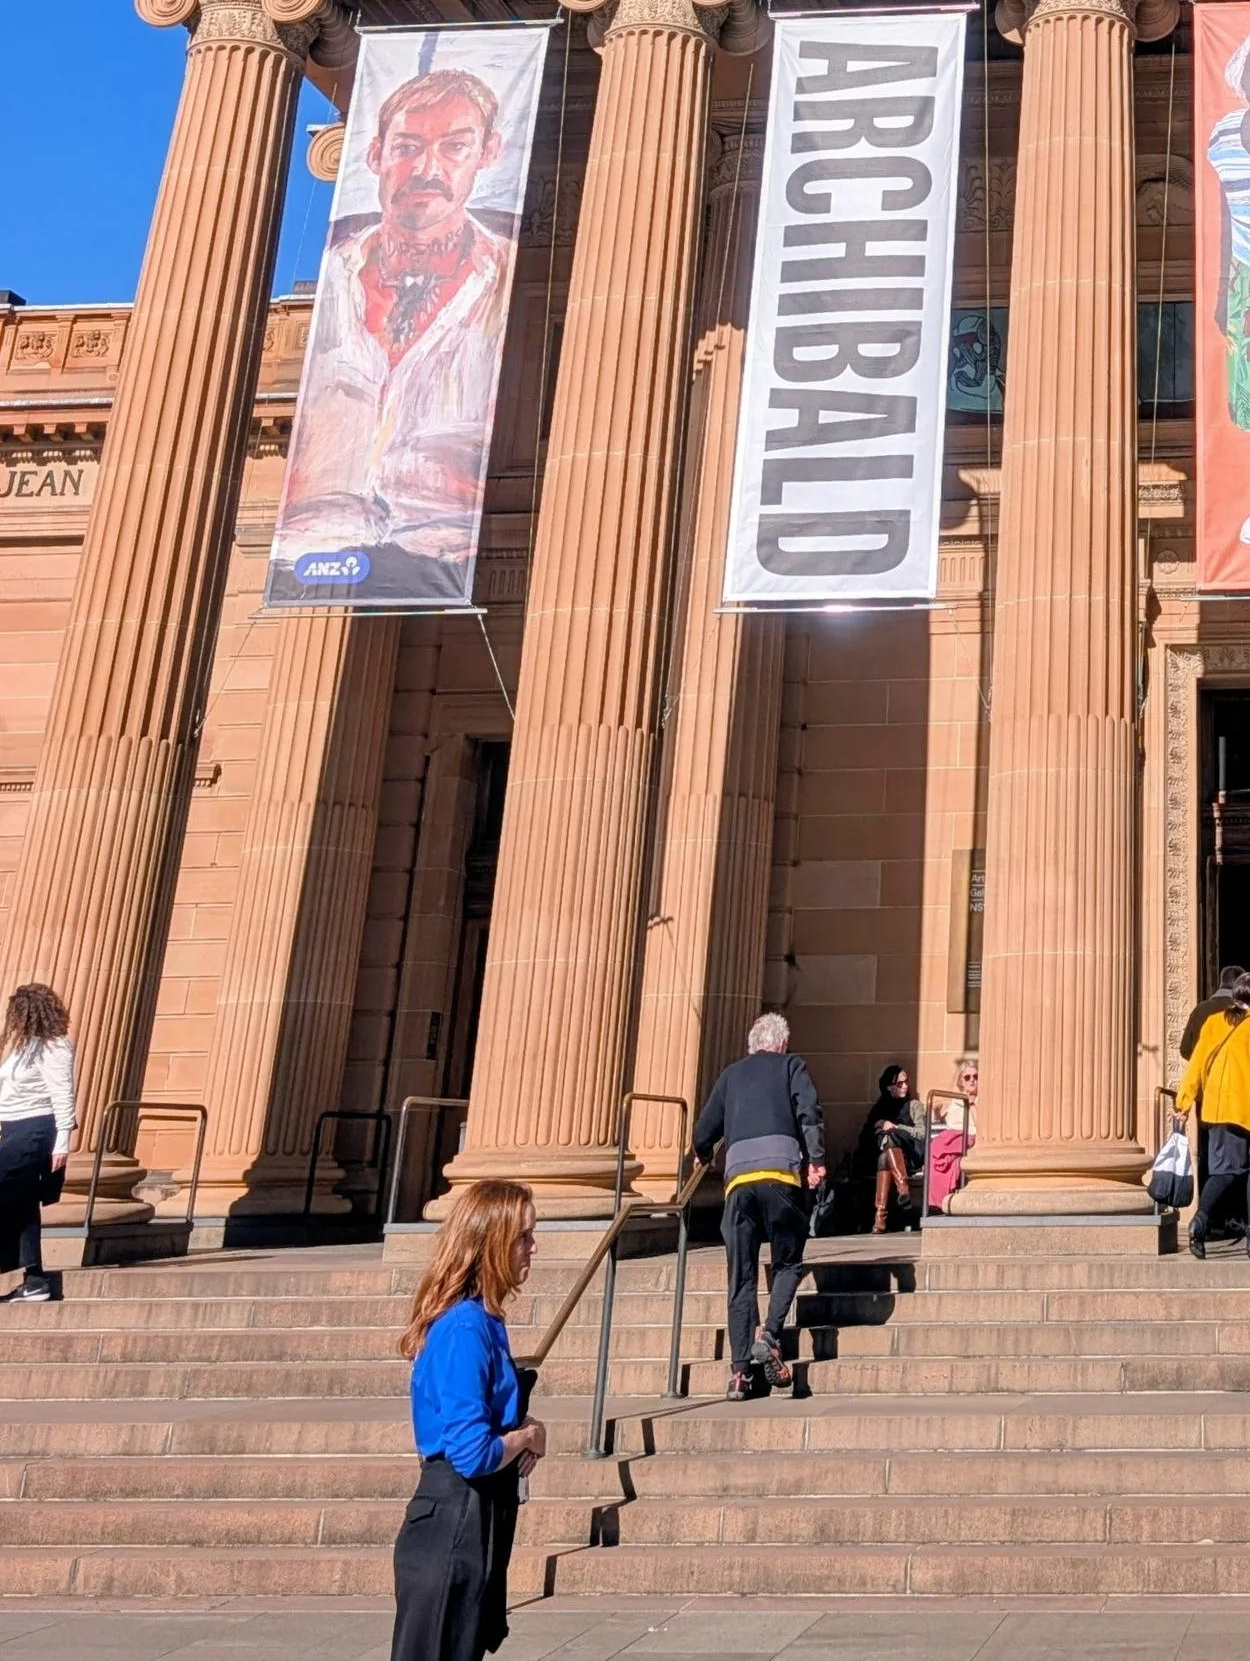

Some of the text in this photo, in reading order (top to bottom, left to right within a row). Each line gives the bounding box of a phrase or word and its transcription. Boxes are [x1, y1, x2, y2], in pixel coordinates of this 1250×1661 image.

[755, 39, 939, 577] ARCHIBALD
[0, 468, 84, 498] JEAN
[303, 561, 342, 577] ANZ
[969, 902, 985, 913] NS
